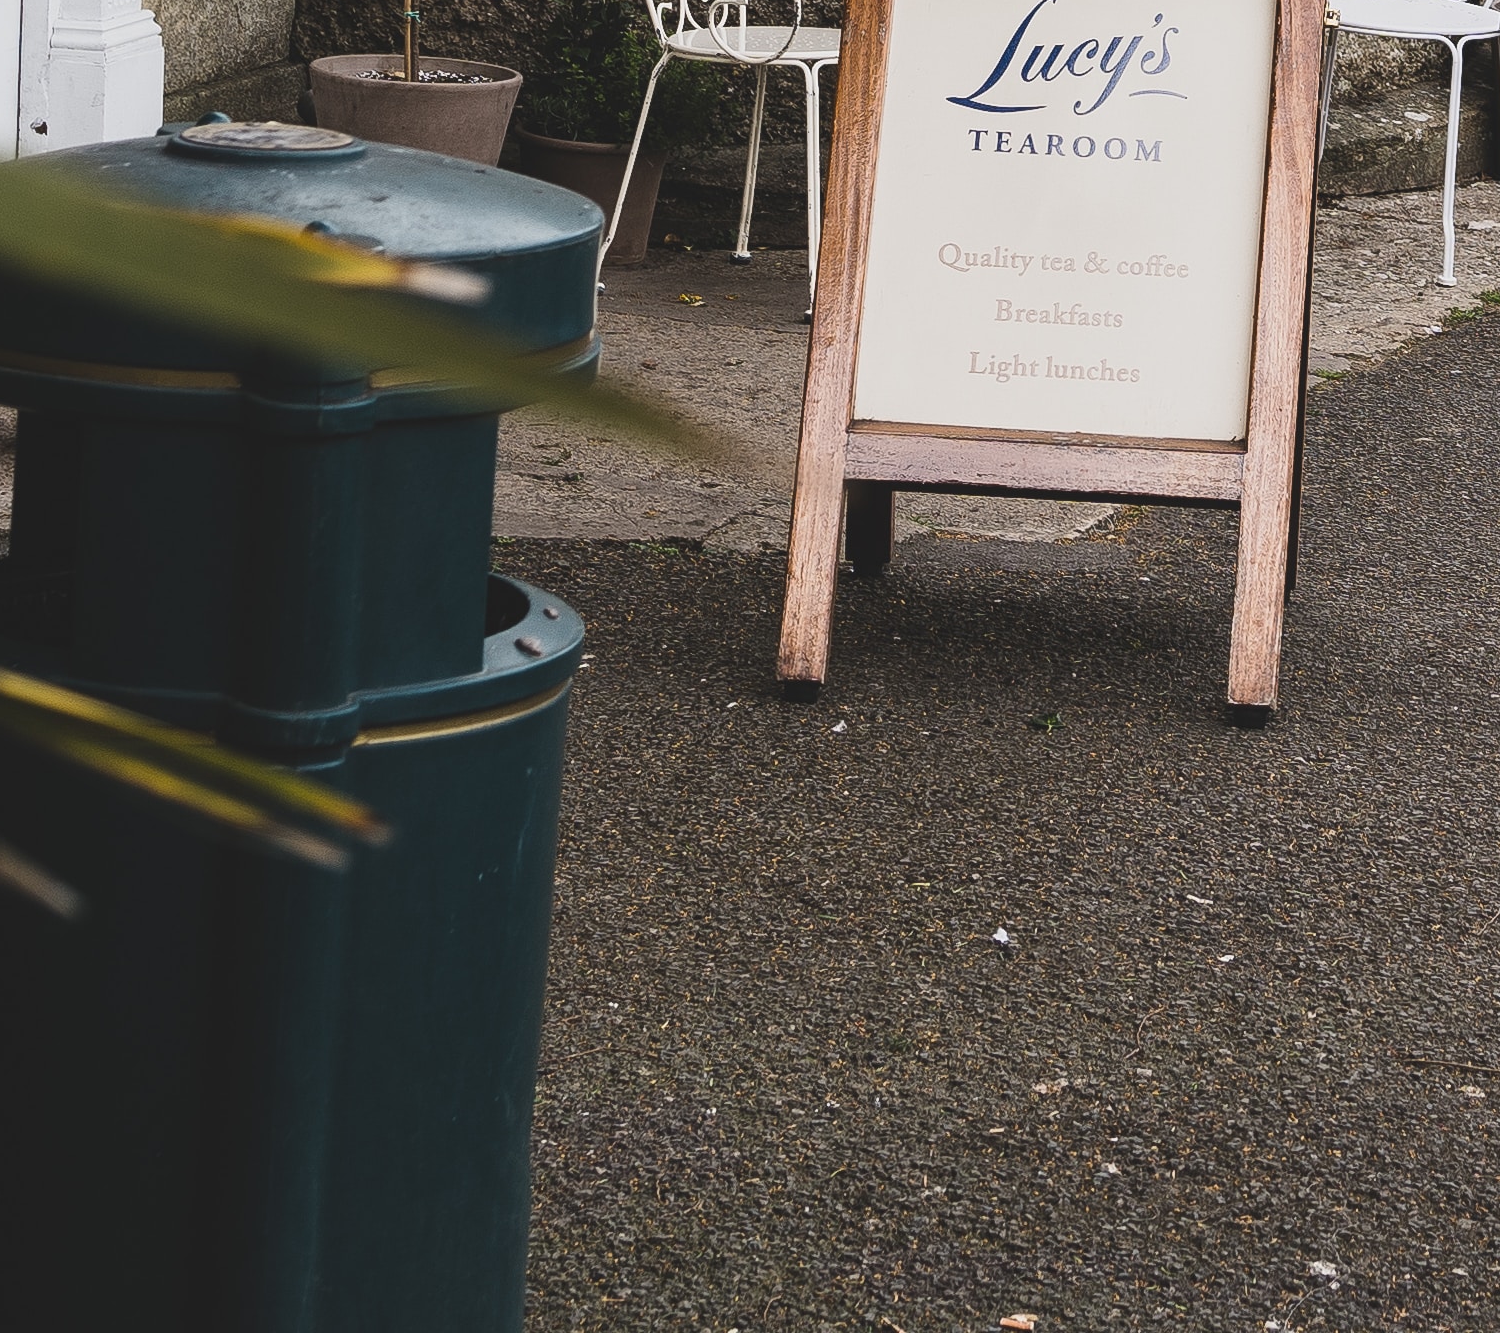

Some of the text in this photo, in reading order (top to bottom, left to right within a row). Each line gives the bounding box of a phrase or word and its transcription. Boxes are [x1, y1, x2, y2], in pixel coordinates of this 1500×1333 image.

[967, 129, 1163, 162] TEAROOM
[937, 242, 1190, 278] Quality tea & coffee
[994, 298, 1124, 328] Breakfasts
[968, 351, 1141, 384] Light lunches
